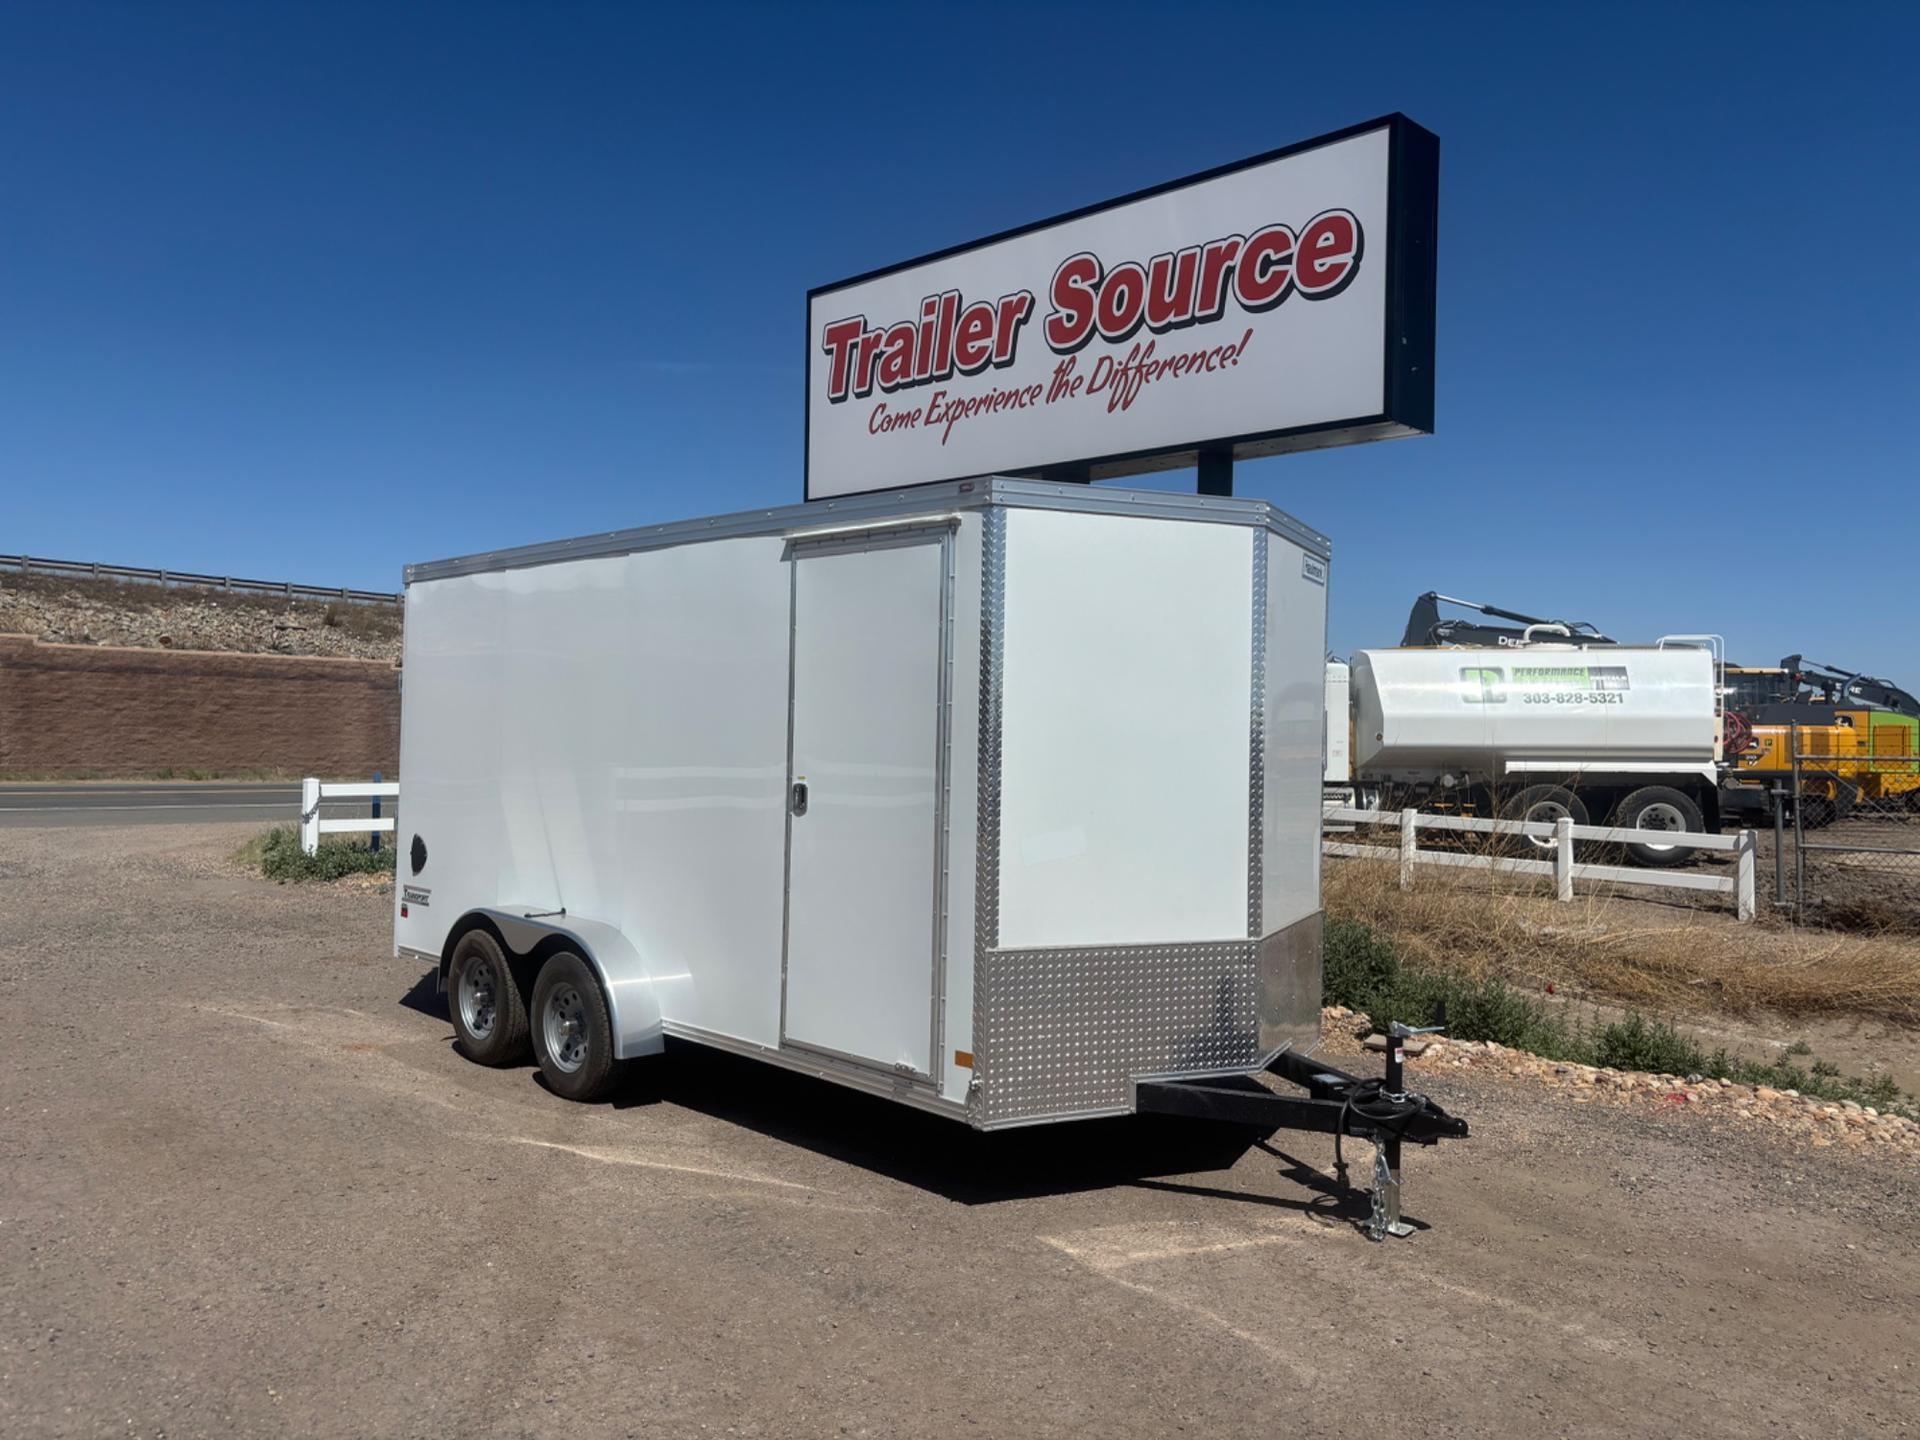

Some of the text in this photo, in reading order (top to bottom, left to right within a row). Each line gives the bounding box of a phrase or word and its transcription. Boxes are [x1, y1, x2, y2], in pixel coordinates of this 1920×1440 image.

[823, 208, 1363, 403] Trailer Source
[868, 328, 1254, 446] Come Experience the Difference!
[1523, 692, 1624, 704] 303-828-5321
